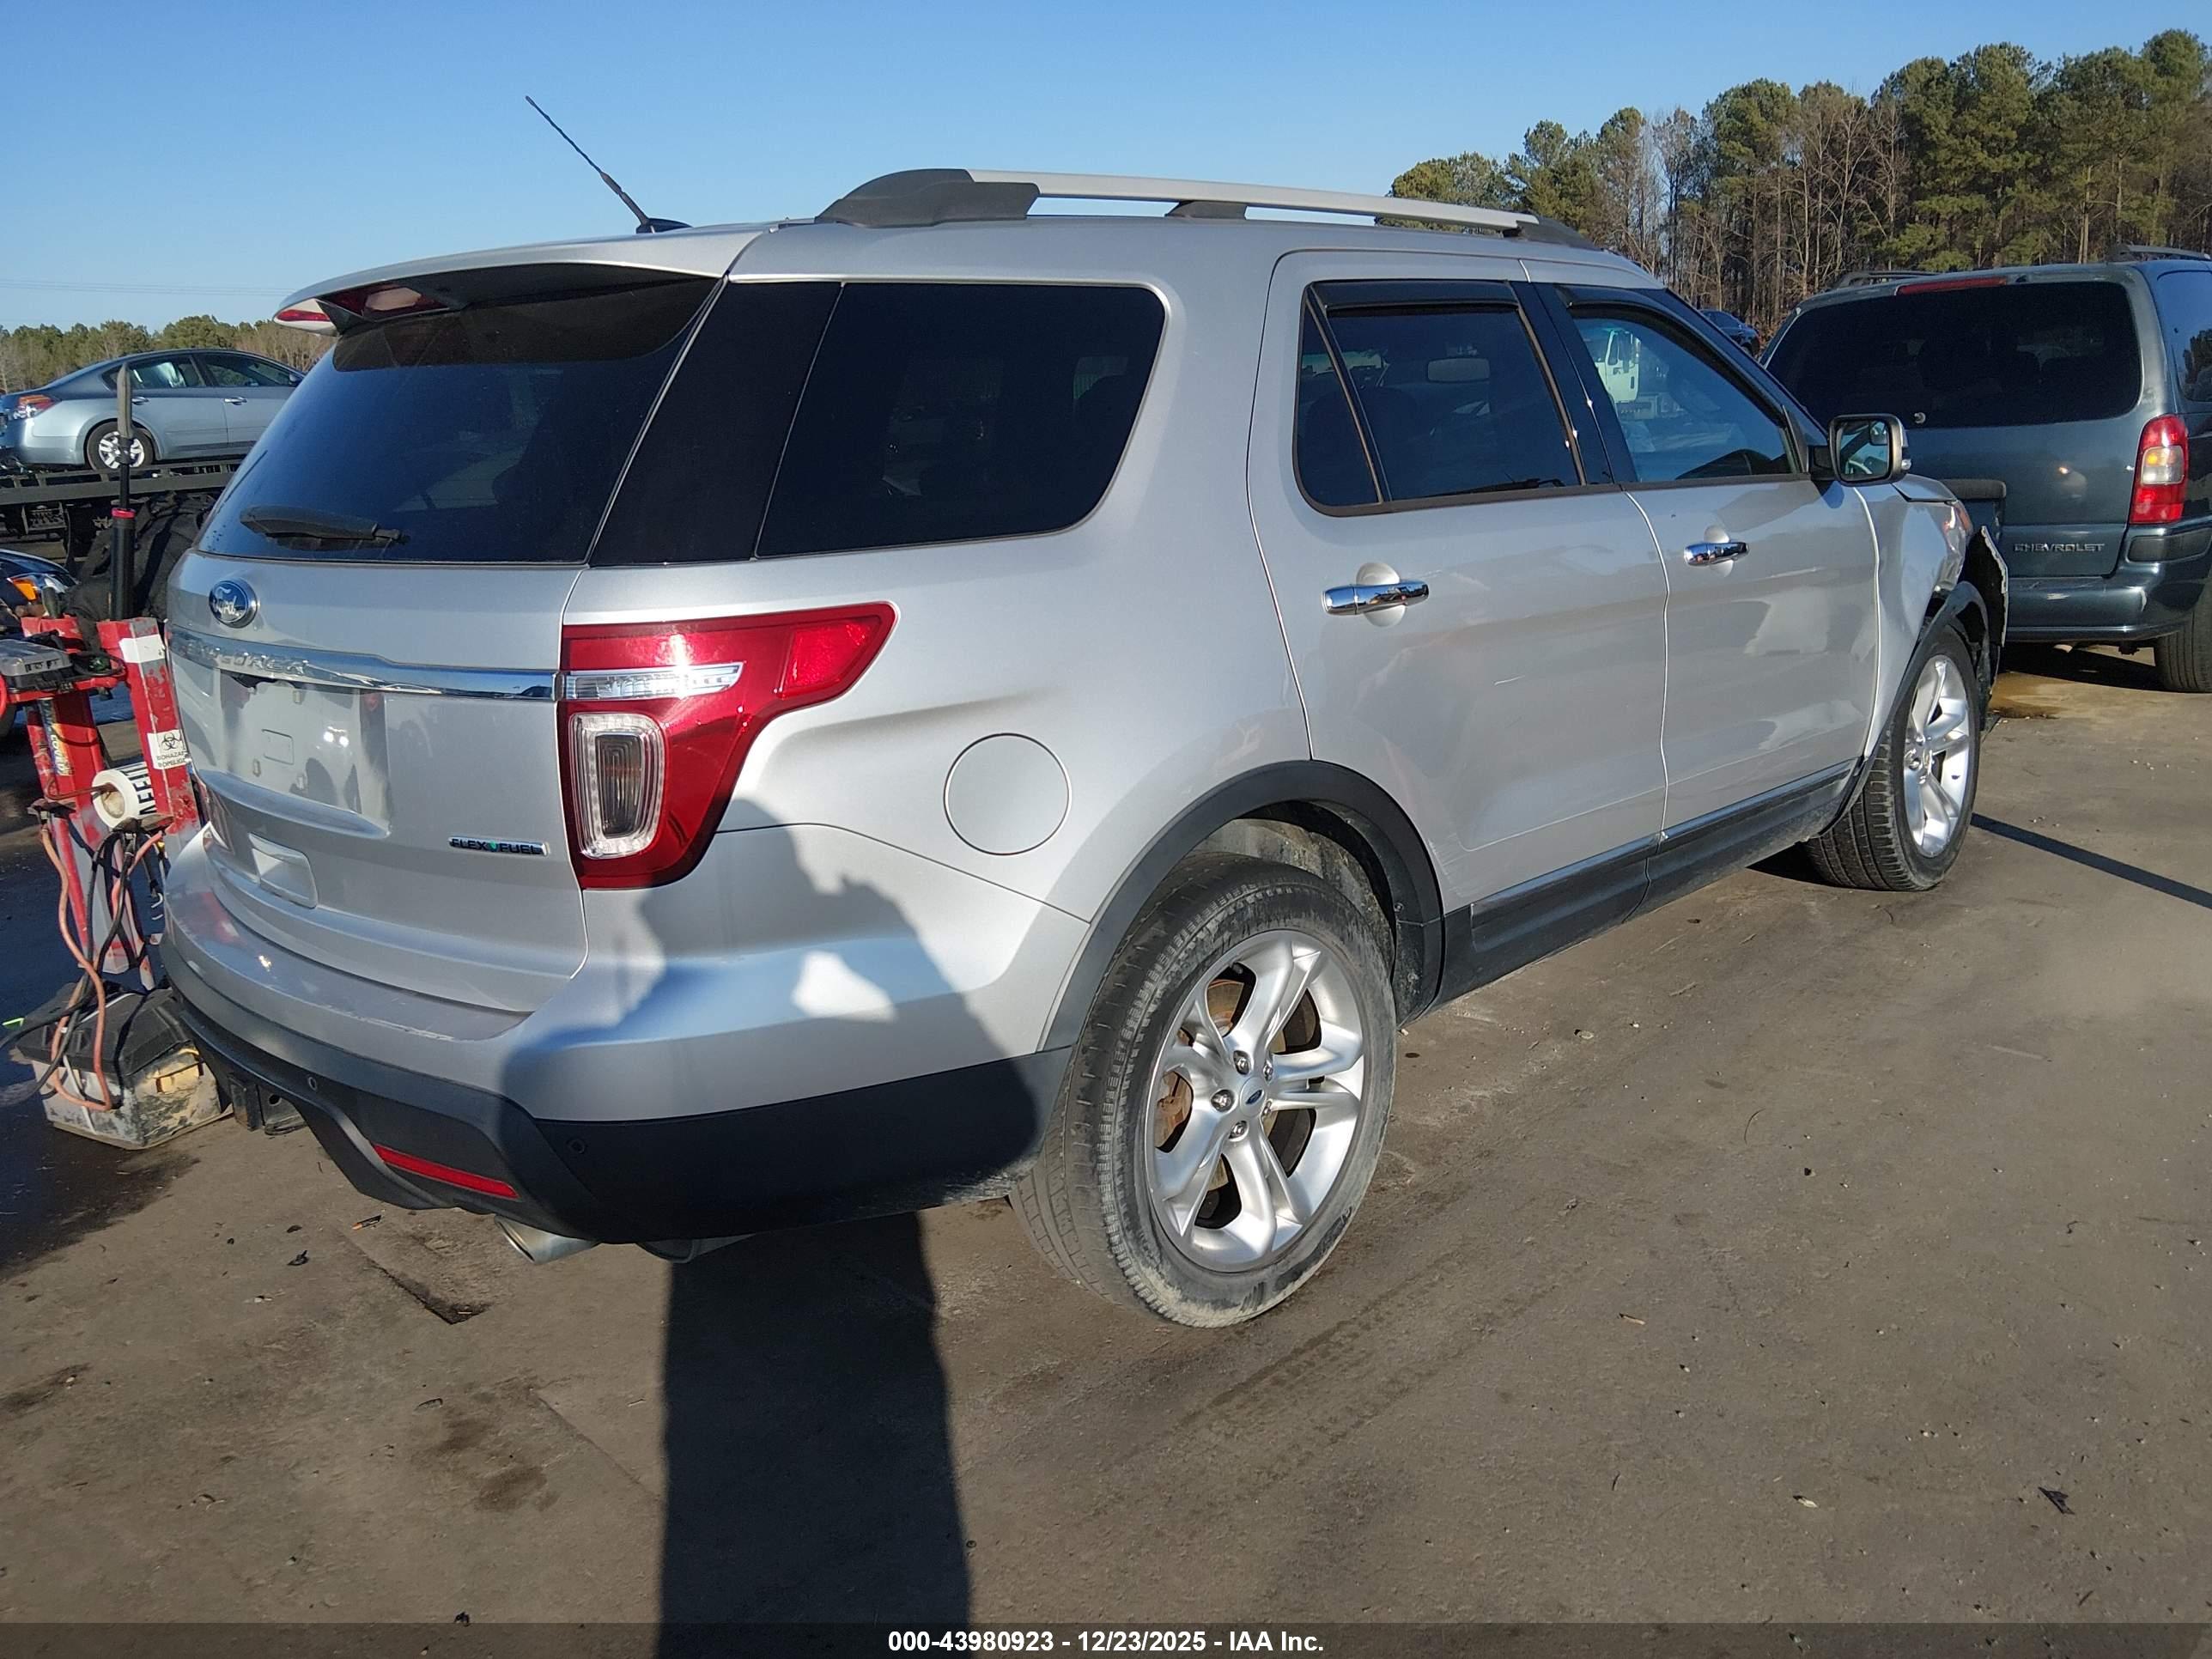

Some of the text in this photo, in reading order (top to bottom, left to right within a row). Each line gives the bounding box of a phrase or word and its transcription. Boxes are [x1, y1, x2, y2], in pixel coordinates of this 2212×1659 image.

[2014, 543, 2106, 552] CHEVROLET
[211, 586, 241, 617] Ford
[451, 838, 543, 855] FLEX FUEL
